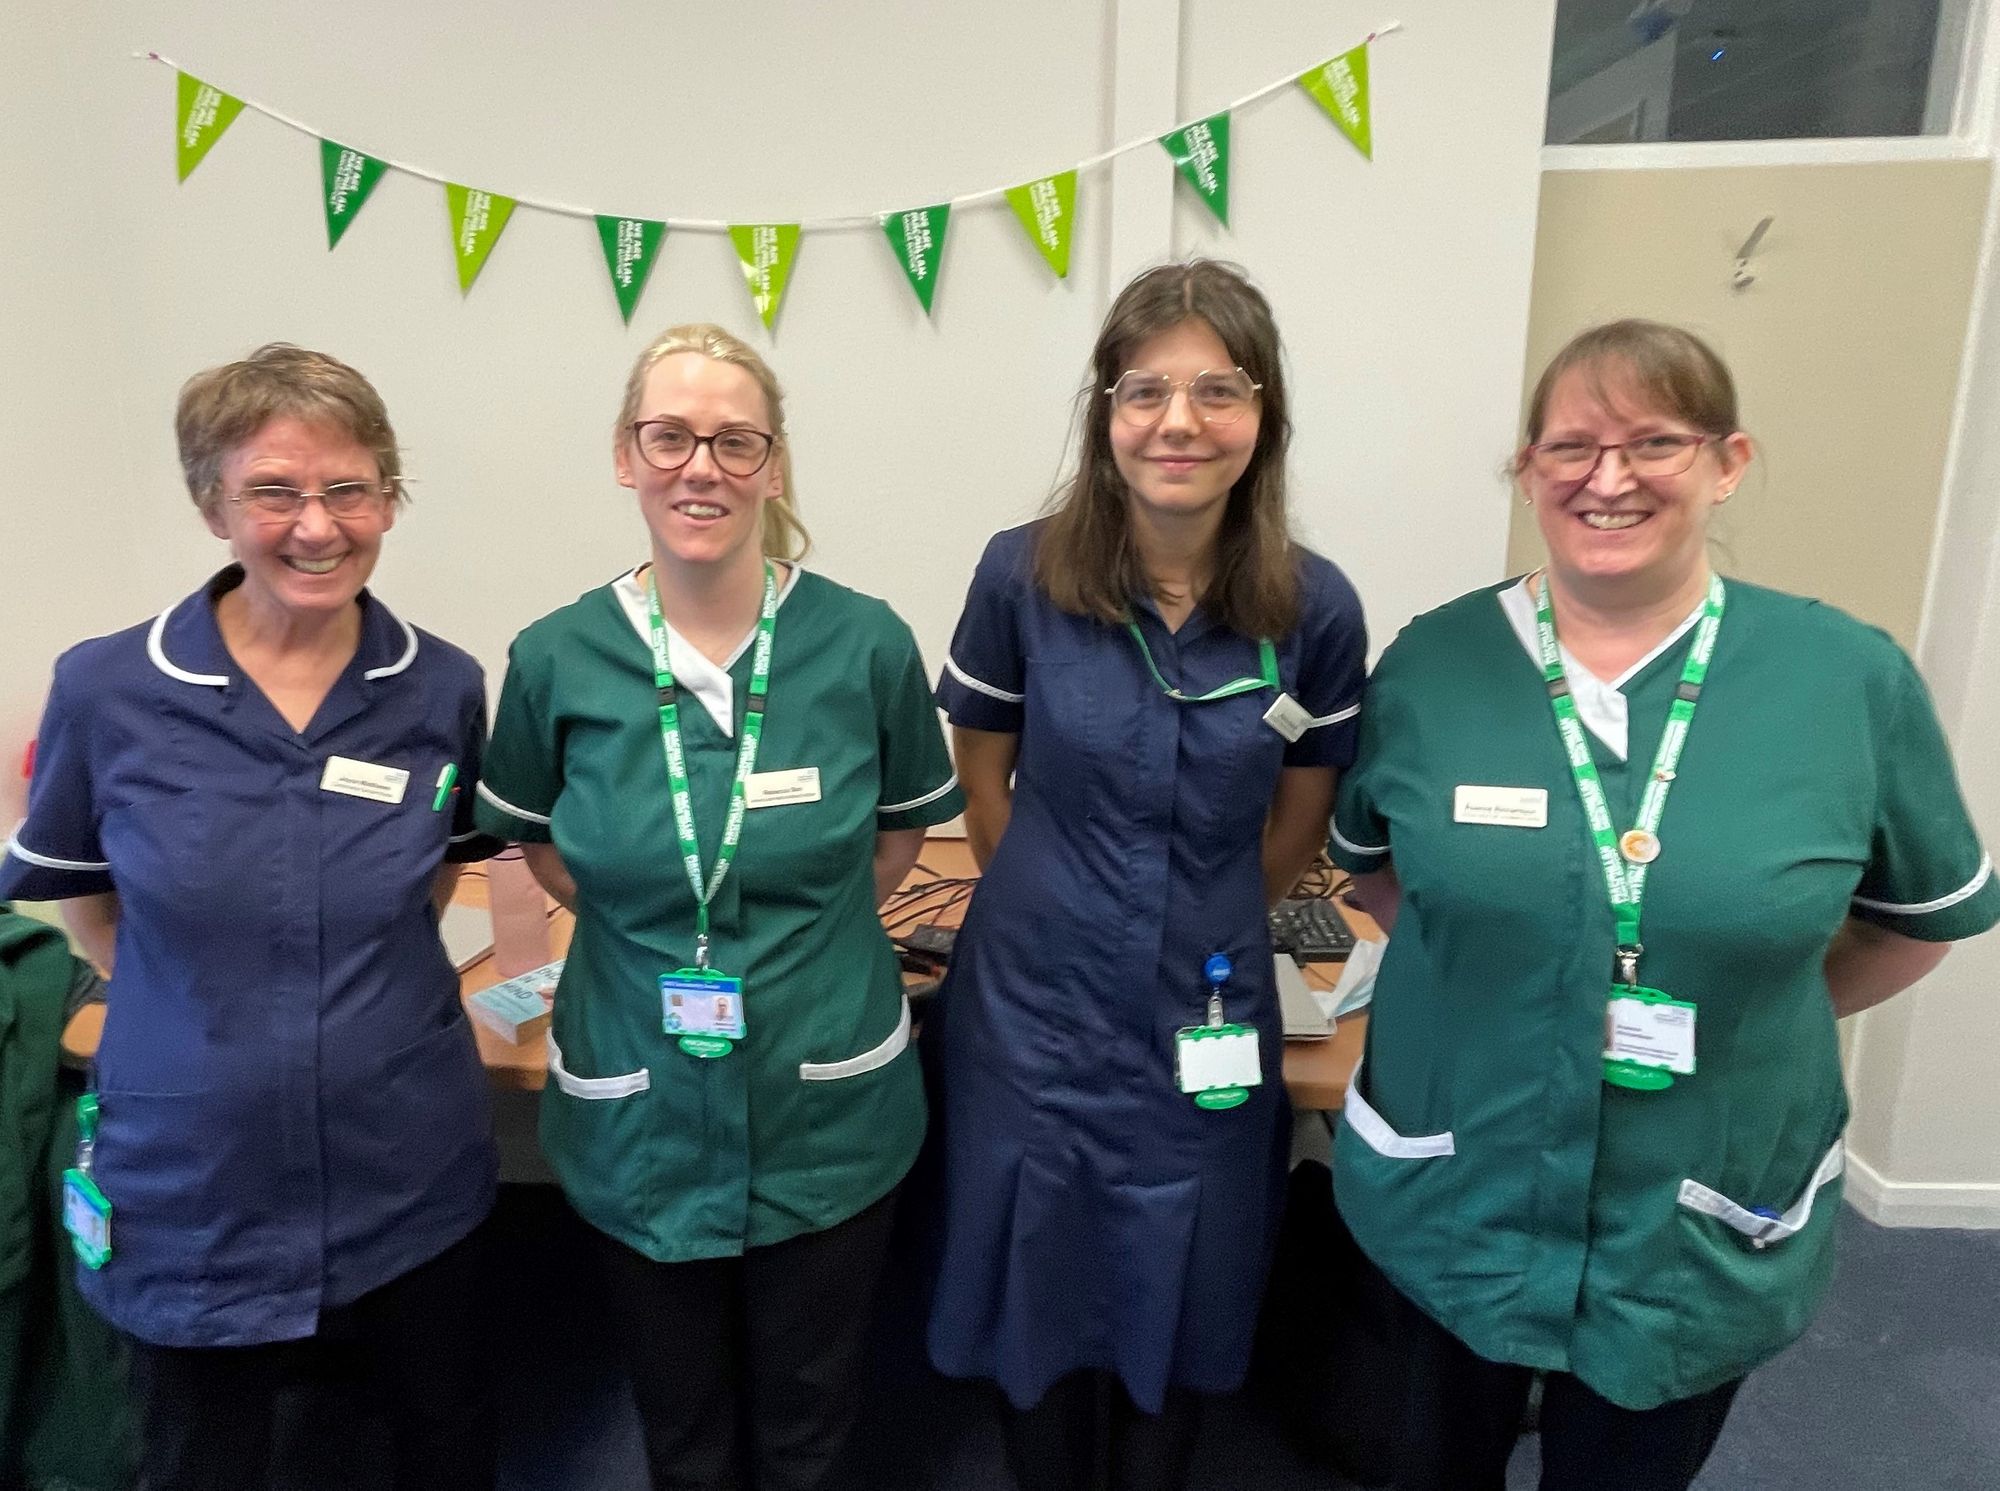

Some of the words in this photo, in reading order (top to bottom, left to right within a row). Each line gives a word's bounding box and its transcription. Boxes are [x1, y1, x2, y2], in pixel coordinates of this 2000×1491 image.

[920, 211, 930, 227] WE
[635, 223, 642, 238] WE
[923, 229, 933, 249] ARE
[634, 240, 642, 259] ARE
